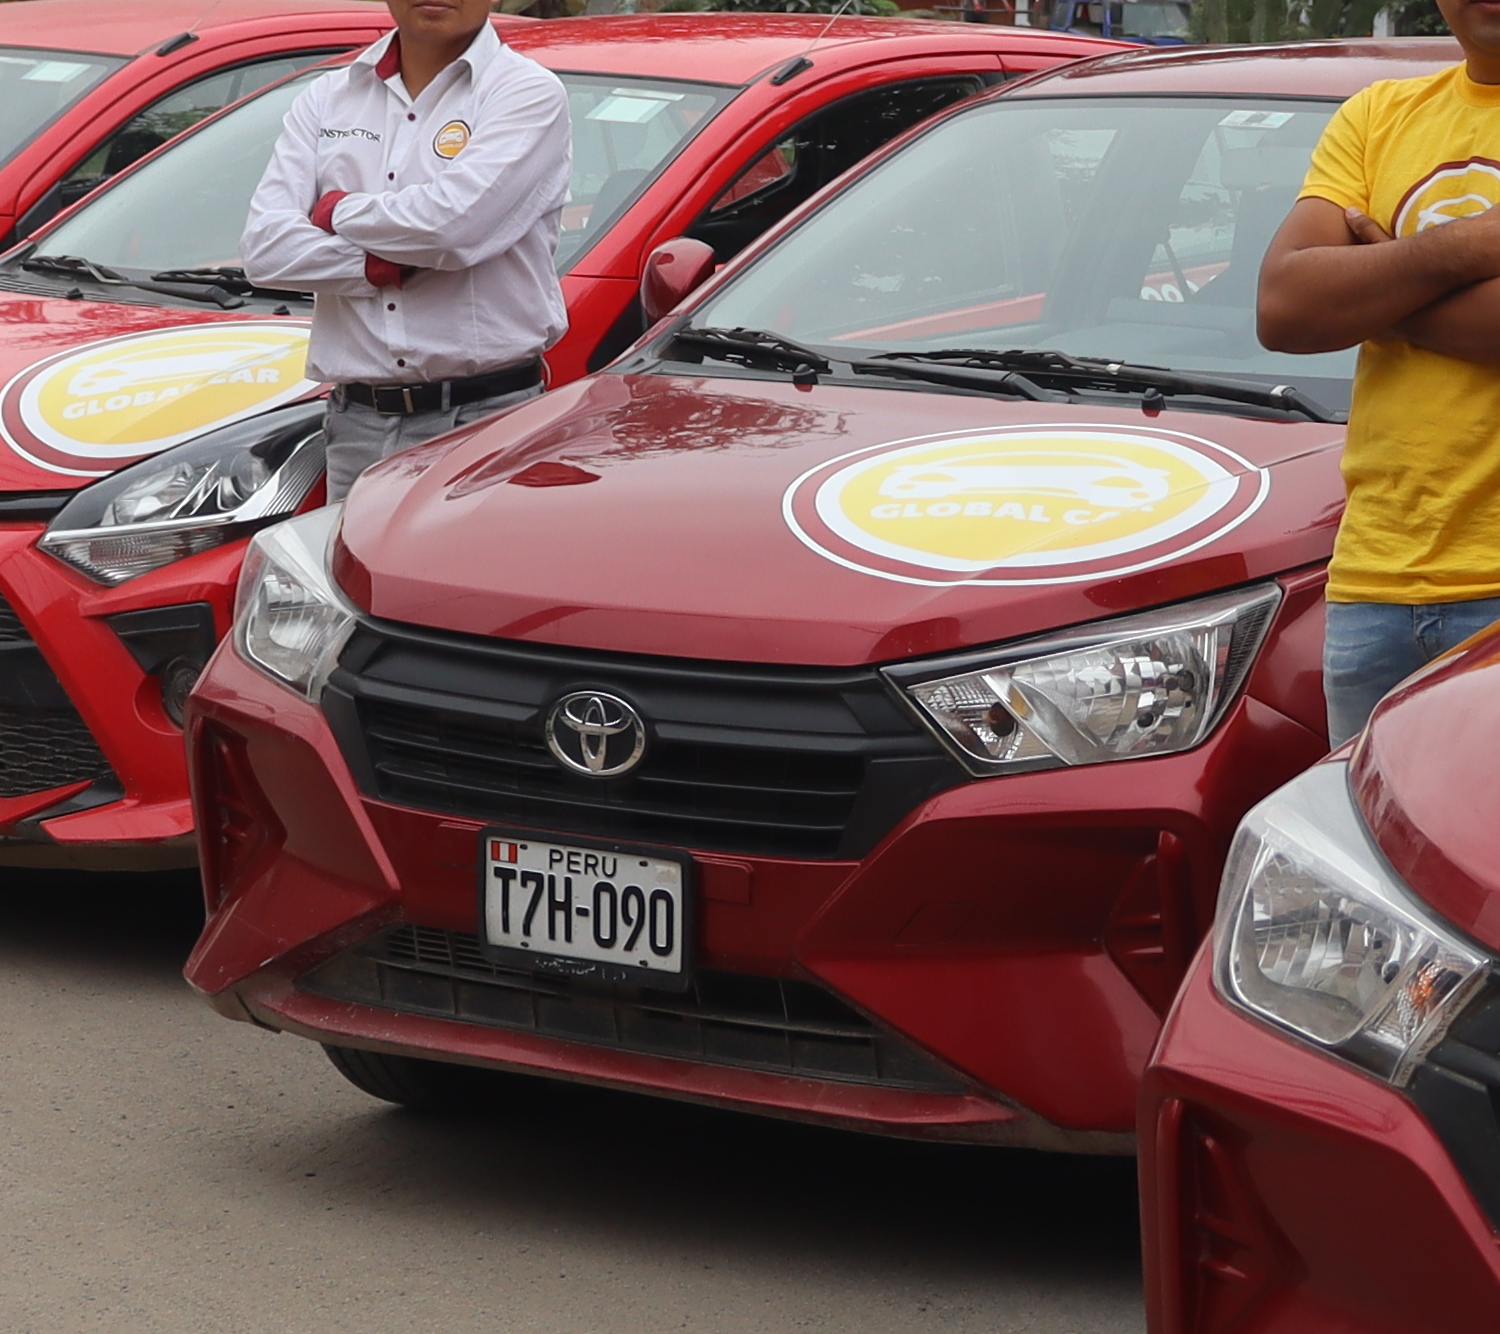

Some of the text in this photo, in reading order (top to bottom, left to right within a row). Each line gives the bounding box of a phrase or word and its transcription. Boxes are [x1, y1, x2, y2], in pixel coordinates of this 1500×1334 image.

[870, 501, 1052, 523] GLOBAL
[549, 848, 618, 878] PERU
[493, 866, 675, 957] T7H-090
